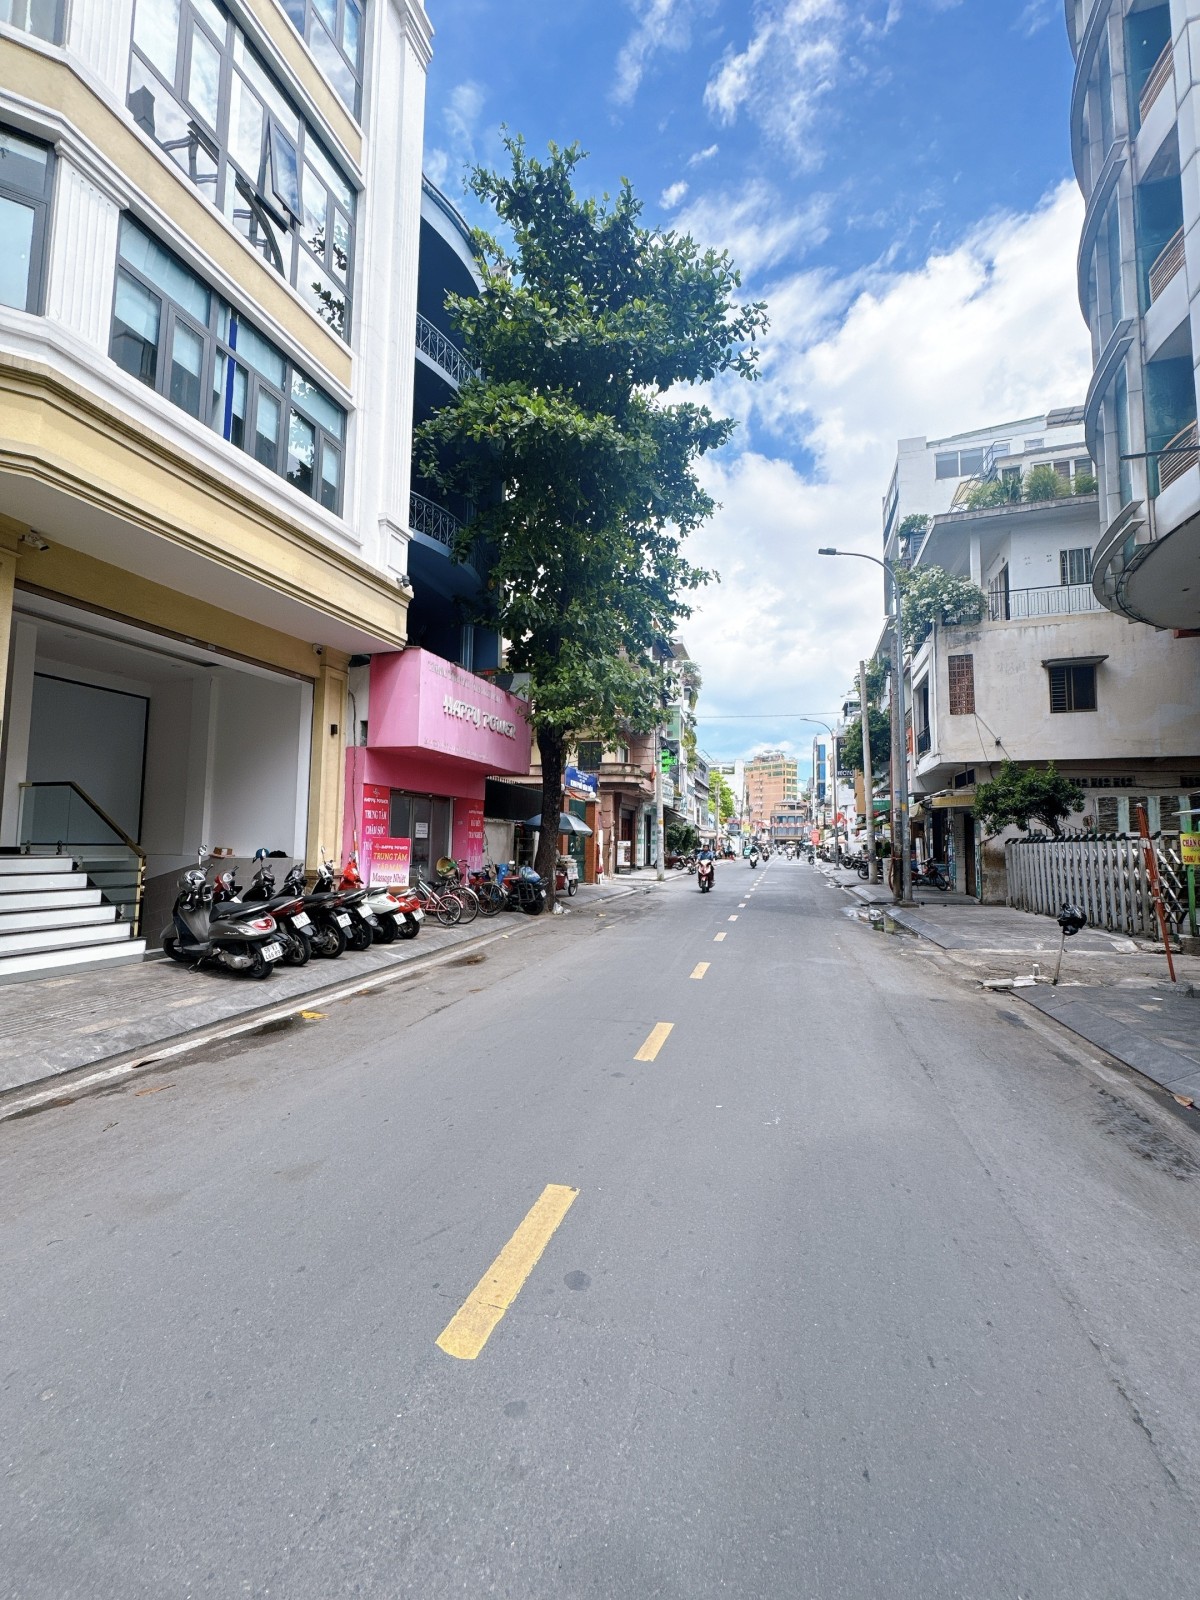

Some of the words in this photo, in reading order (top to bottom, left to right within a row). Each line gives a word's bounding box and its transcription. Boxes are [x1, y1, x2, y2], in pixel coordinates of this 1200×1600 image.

[443, 694, 480, 730] HAPPY
[482, 711, 516, 741] POWER
[373, 852, 393, 861] TRUNG
[394, 852, 408, 861] TÂM
[372, 872, 392, 884] Massage
